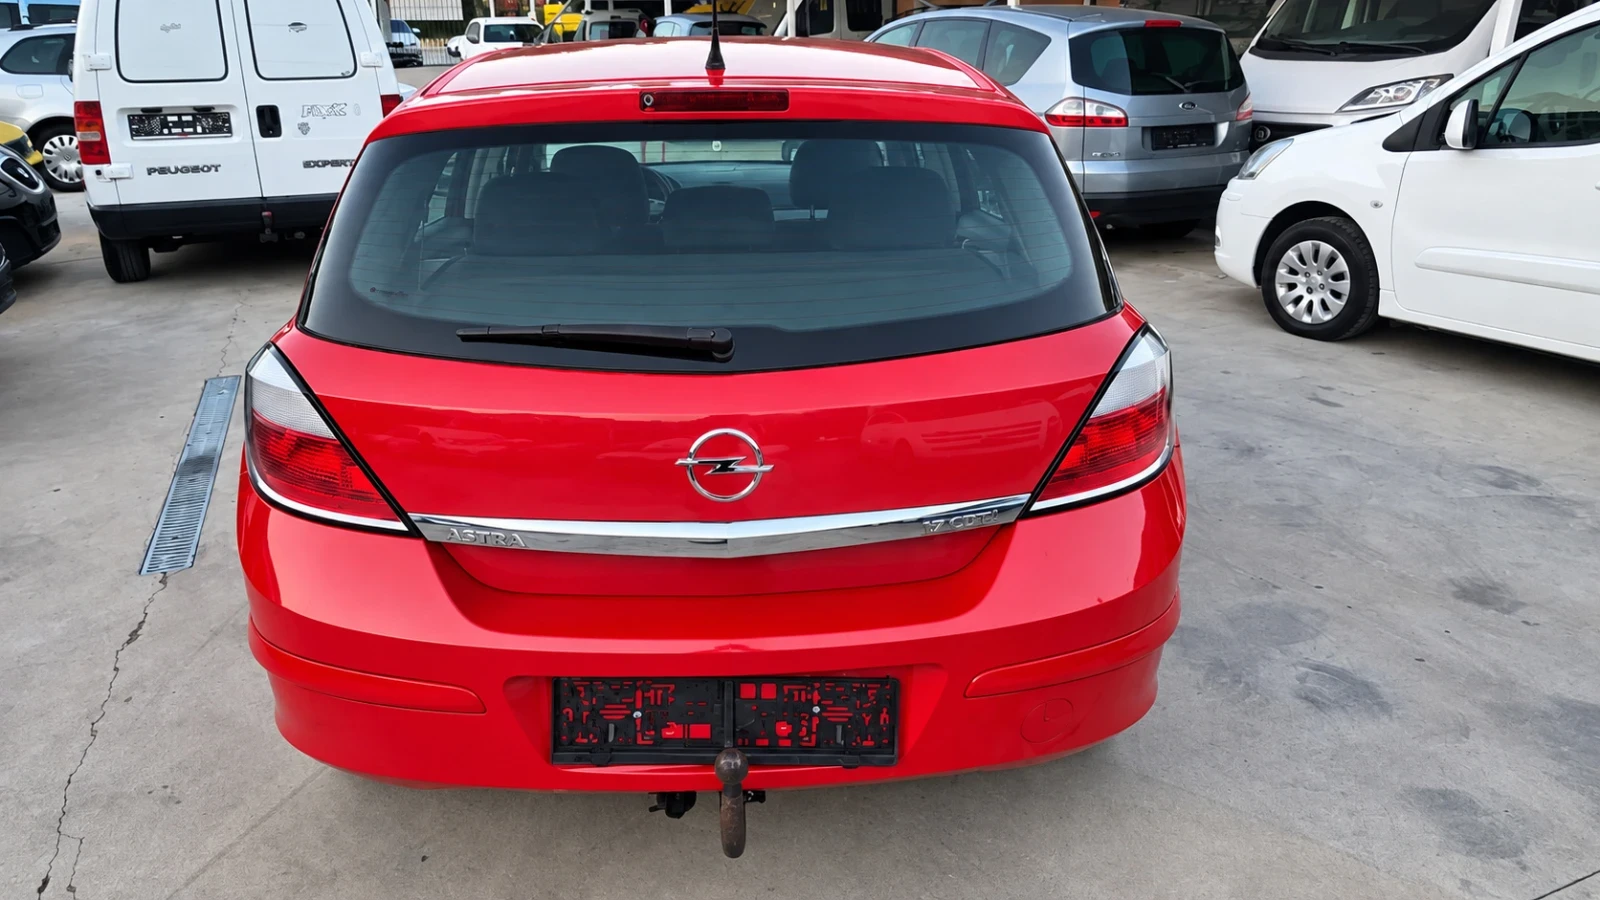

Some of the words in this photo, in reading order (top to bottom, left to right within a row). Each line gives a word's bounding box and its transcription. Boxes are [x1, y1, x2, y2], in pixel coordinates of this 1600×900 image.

[146, 164, 221, 176] PEUGEOT
[303, 159, 356, 169] EXPERT
[447, 527, 527, 547] ASTRA
